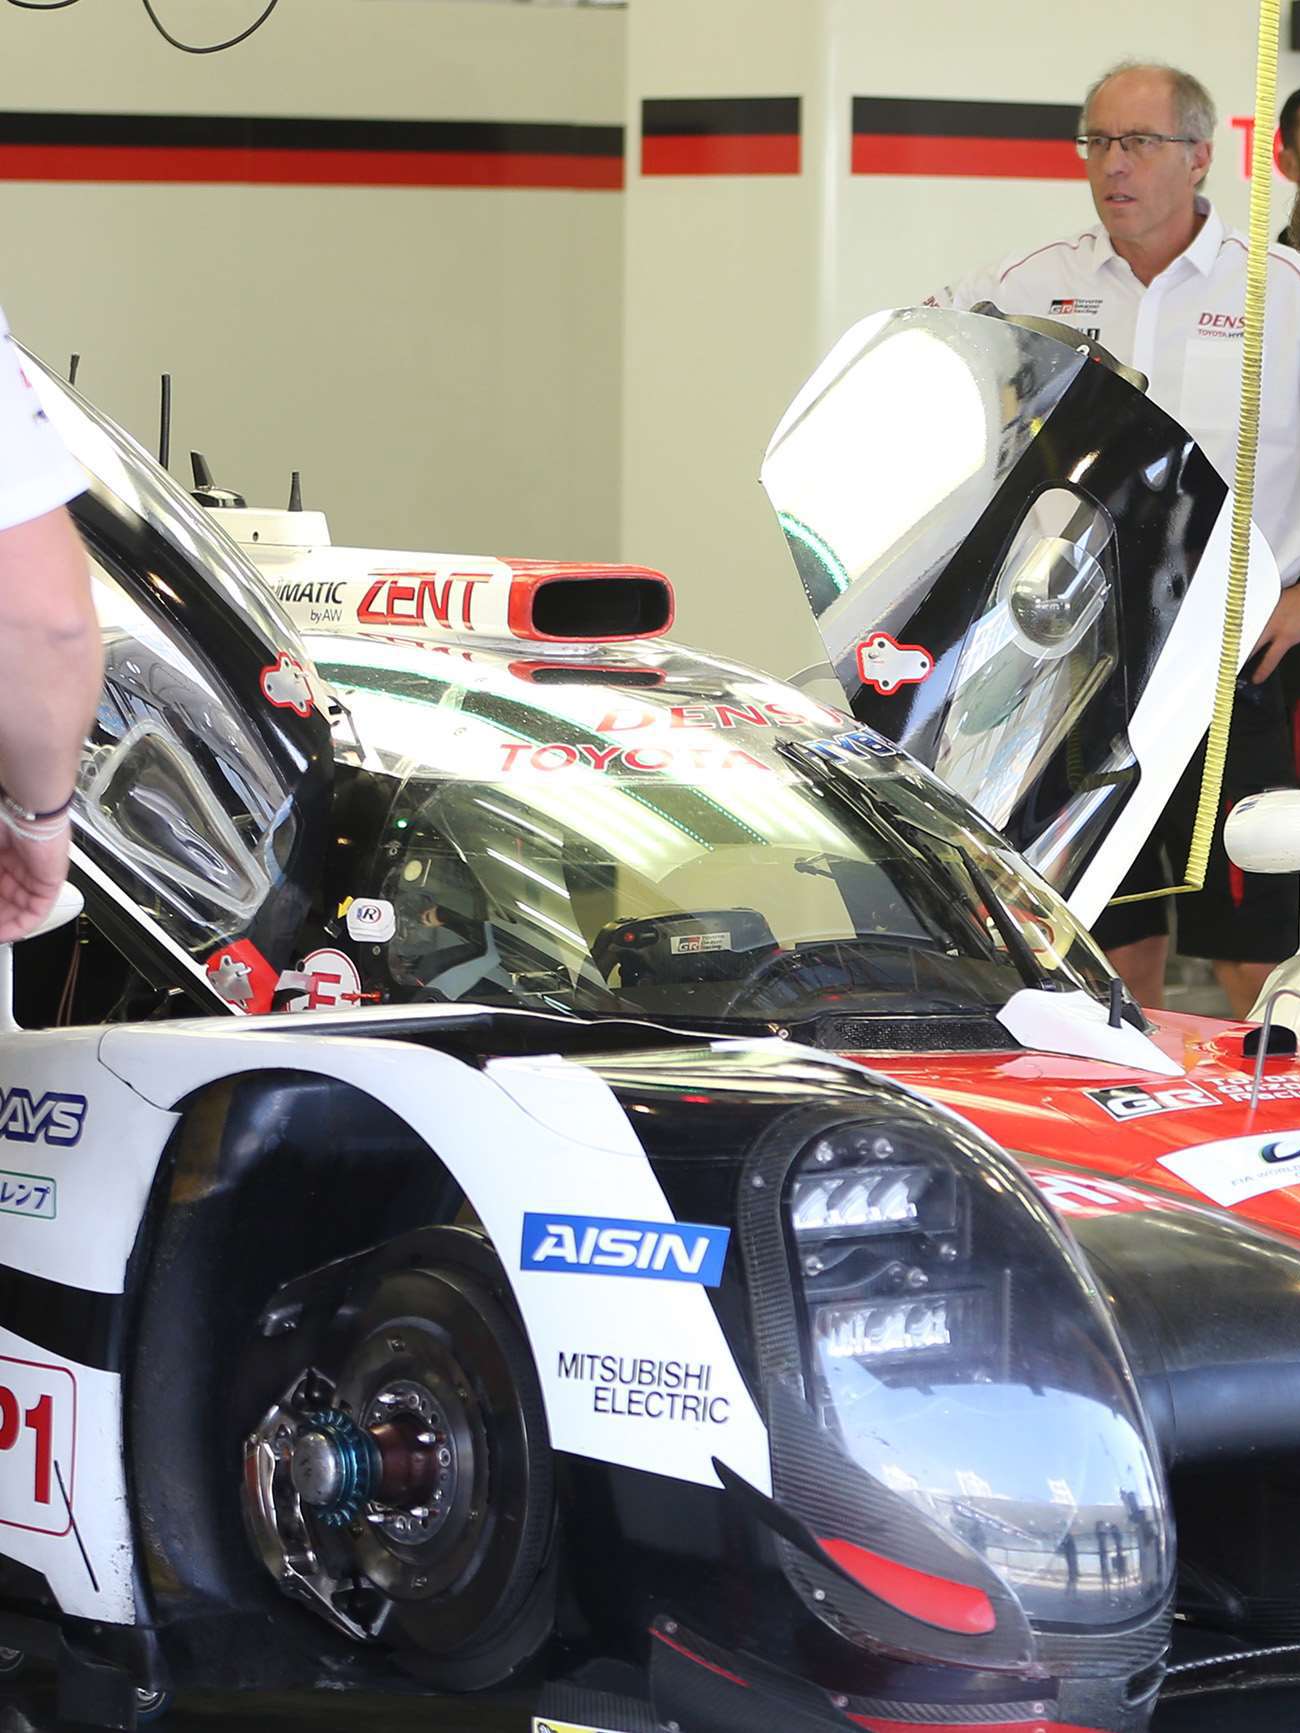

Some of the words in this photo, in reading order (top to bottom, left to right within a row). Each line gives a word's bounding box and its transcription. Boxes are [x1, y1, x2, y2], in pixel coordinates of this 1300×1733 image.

[1198, 312, 1247, 328] DENS
[357, 571, 493, 631] ZENT
[0, 1096, 85, 1139] AYS
[1104, 1086, 1217, 1118] GR
[532, 1223, 710, 1275] AISIN
[557, 1352, 712, 1391] MITSUBISHI
[593, 1387, 730, 1424] ELECTRIC
